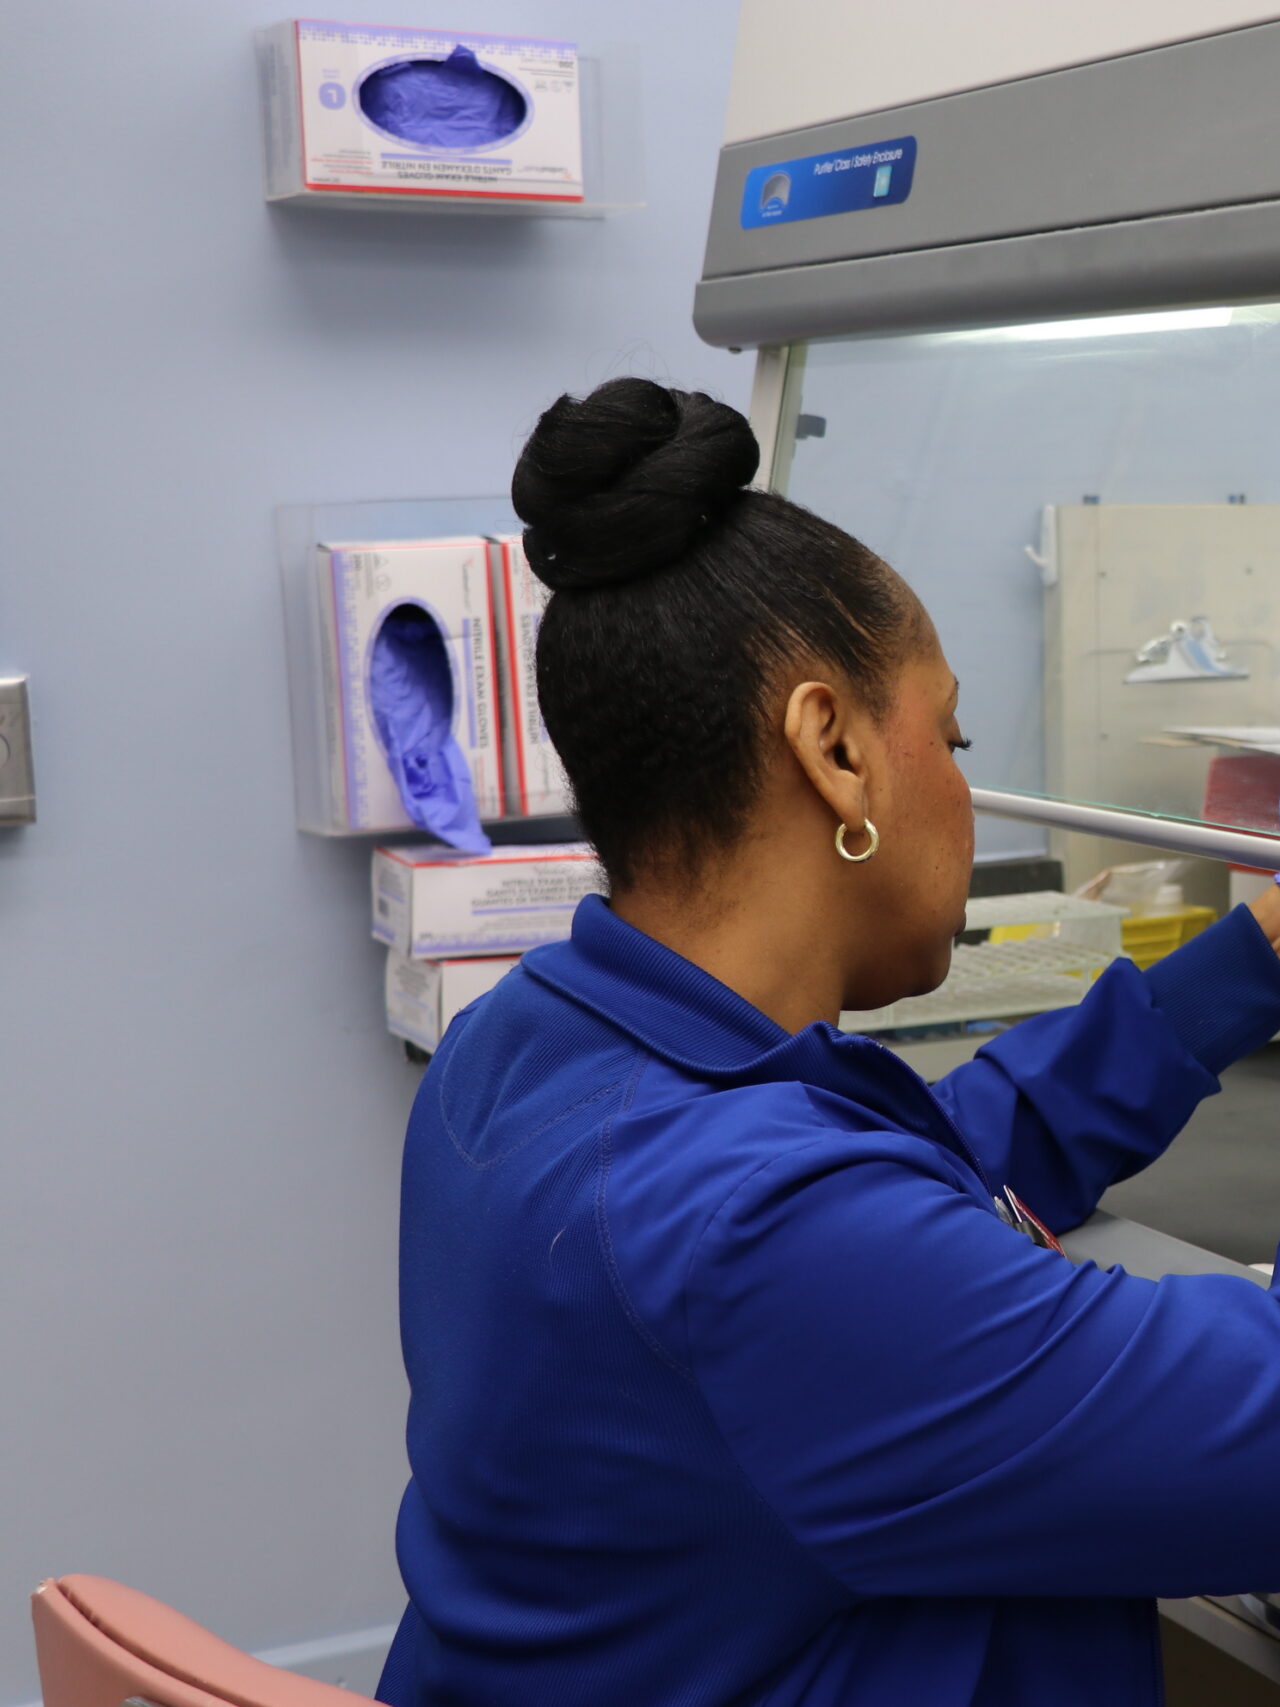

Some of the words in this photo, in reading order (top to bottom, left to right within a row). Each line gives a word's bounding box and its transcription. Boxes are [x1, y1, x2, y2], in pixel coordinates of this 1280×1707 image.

[472, 617, 484, 660] NITRILE
[474, 664, 486, 700] EXAM
[476, 702, 489, 749] GLOVES
